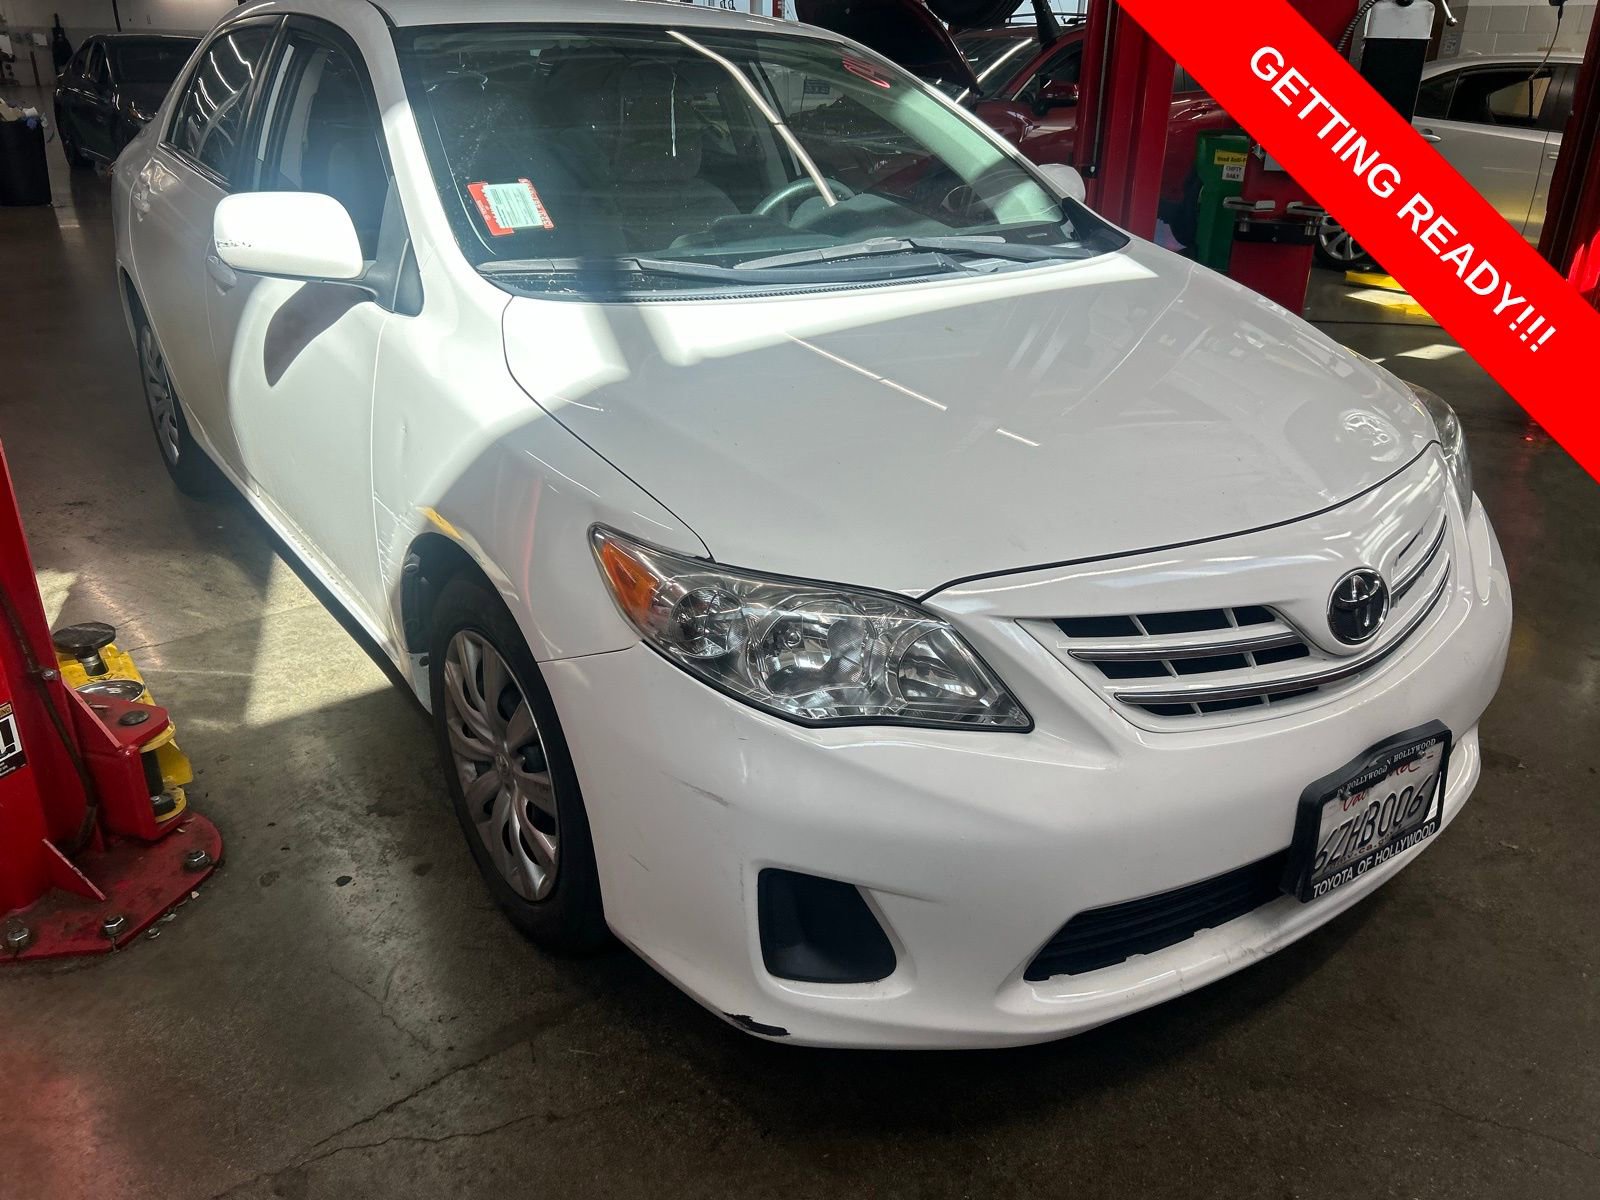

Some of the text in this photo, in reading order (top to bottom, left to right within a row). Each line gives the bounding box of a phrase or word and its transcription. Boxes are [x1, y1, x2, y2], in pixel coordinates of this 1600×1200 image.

[1393, 738, 1437, 763] HOLLYWOOD
[1313, 822, 1436, 898] TOYOTA OF HOLLYWOOD
[1314, 775, 1433, 873] 6ZHB006
